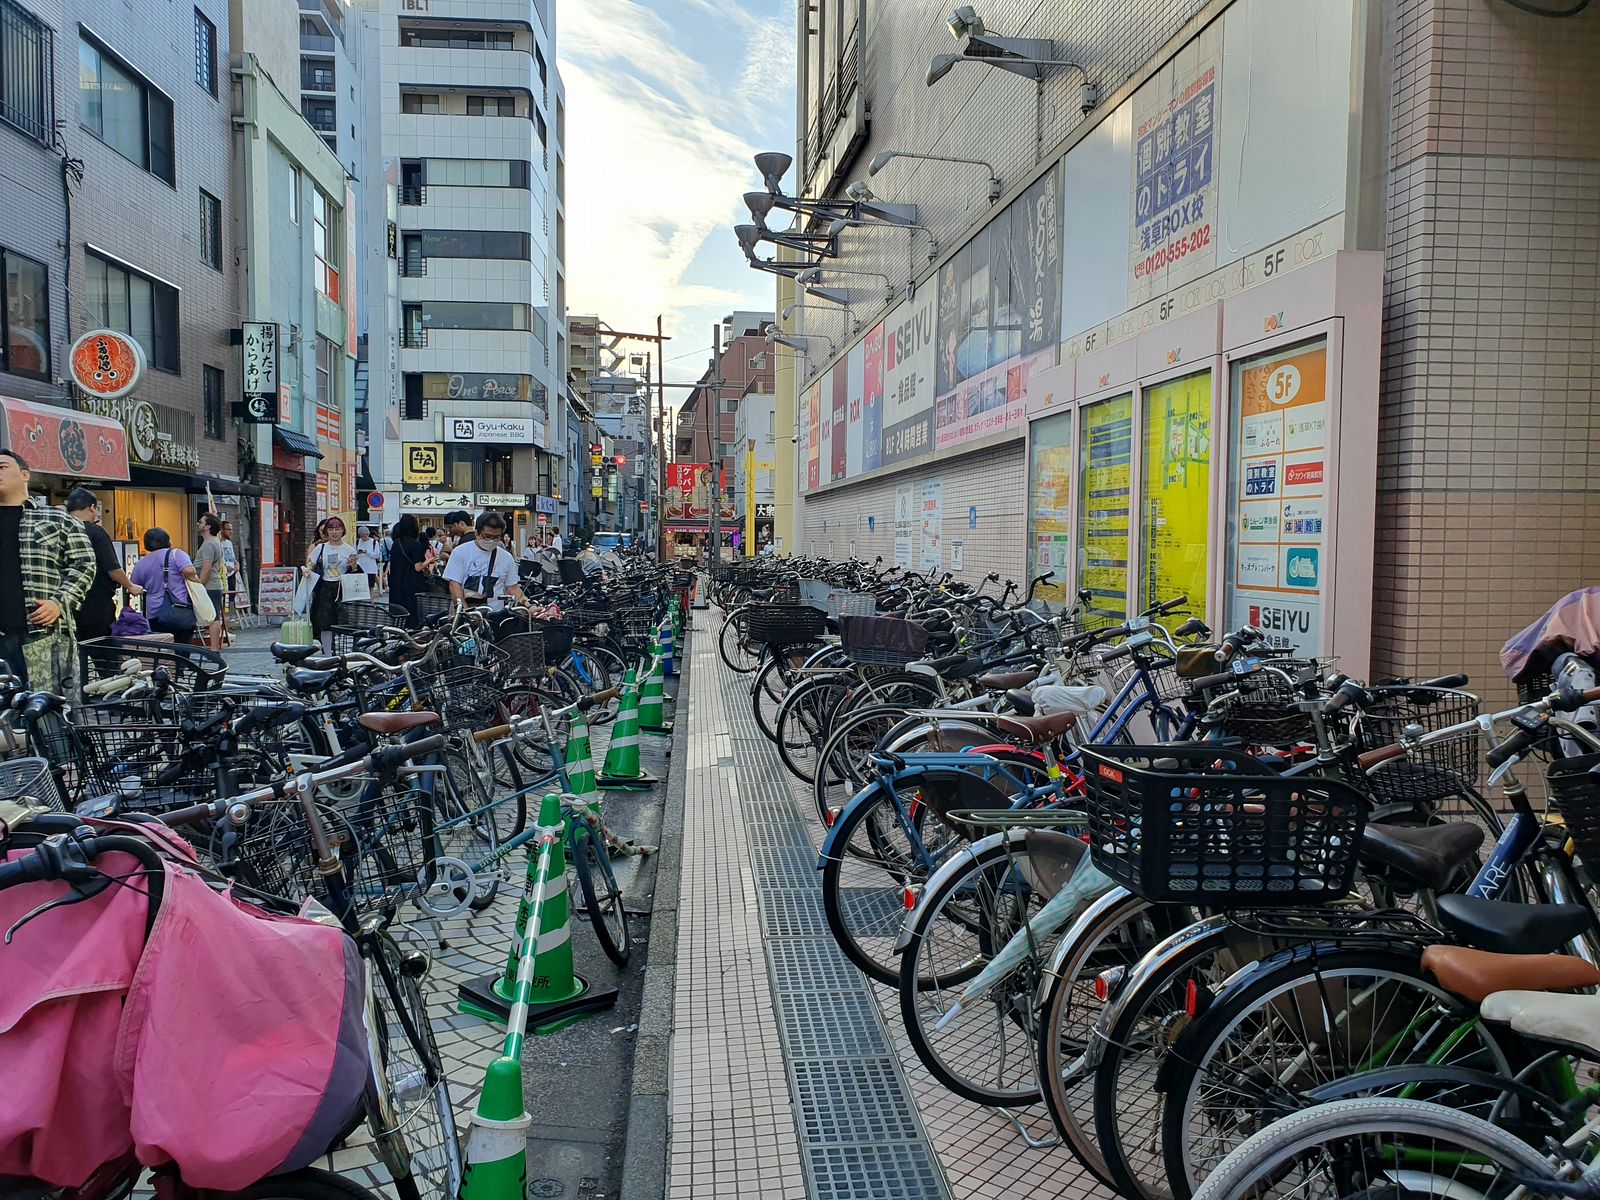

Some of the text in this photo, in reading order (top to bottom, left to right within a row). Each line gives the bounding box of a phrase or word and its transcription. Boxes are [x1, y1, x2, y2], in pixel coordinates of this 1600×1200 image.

[1139, 93, 1212, 175] 個別教室
[1138, 142, 1209, 217] のトライ
[1085, 333, 1097, 351] 5F
[1159, 297, 1174, 321] 5F
[1264, 249, 1285, 277] 5F
[896, 301, 933, 365] SEIYU
[1263, 310, 1285, 333] ROX
[246, 333, 260, 391] からあげ
[260, 325, 274, 383] 揚げたて
[447, 374, 478, 398] One
[1275, 371, 1292, 399] 5F
[456, 422, 473, 436] 牛角
[478, 422, 524, 432] Gyu-Kaku
[412, 450, 435, 469] 牛角
[1247, 466, 1275, 480] 個別教室
[682, 467, 692, 497] ケバブ
[1246, 481, 1274, 493] のトライ
[1284, 518, 1322, 534] 体操教室
[1262, 606, 1310, 634] SEIYU
